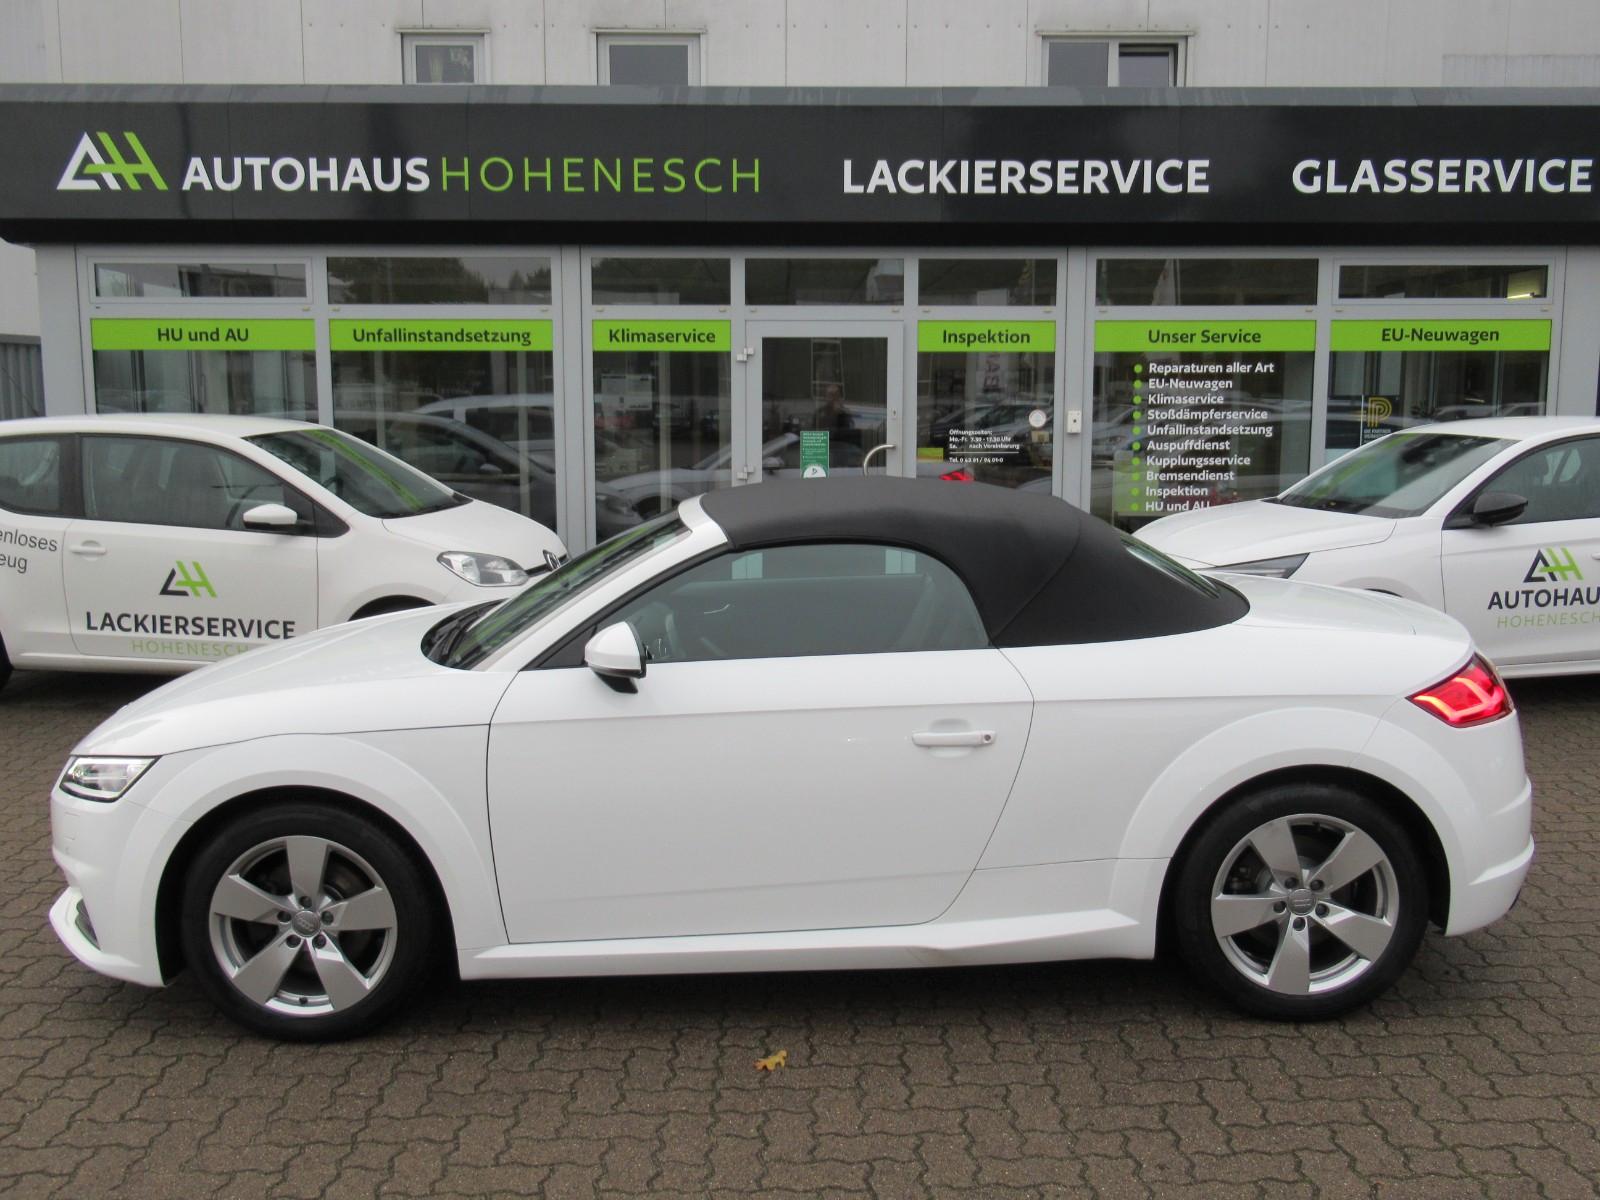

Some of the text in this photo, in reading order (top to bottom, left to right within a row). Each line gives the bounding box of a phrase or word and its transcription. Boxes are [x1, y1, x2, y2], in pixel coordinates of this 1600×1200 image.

[182, 156, 762, 194] AUTOHAUS HOHENESCH
[842, 158, 1211, 195] LACKIERSERVICE
[1292, 157, 1593, 194] GLASSERVICE
[157, 327, 249, 342] HU und AU
[352, 328, 533, 347] Unfallinstandsetzung
[608, 328, 717, 344] Klimaservice
[942, 329, 1031, 347] Inspektion
[1148, 329, 1262, 344] Unser Service
[1381, 327, 1500, 346] EU-Neuwagen
[1149, 362, 1275, 376] Reparaturen aller Art
[1148, 378, 1233, 391] EU-Neuwagen
[1148, 393, 1224, 405] Klimaservice
[1147, 408, 1268, 422] Stoßdämpferservice
[1147, 424, 1273, 437] Unfallinstandsetzung
[1146, 439, 1231, 454] Auspuffdienst
[1146, 454, 1251, 468] Kupplungsservice
[1146, 470, 1235, 481] Bremsendienst
[1145, 485, 1208, 499] Inspektion
[1145, 501, 1164, 512] HU
[1166, 501, 1190, 511] und
[1487, 586, 1600, 610] AUTOHAU
[86, 611, 296, 640] LACKIERSERVICE
